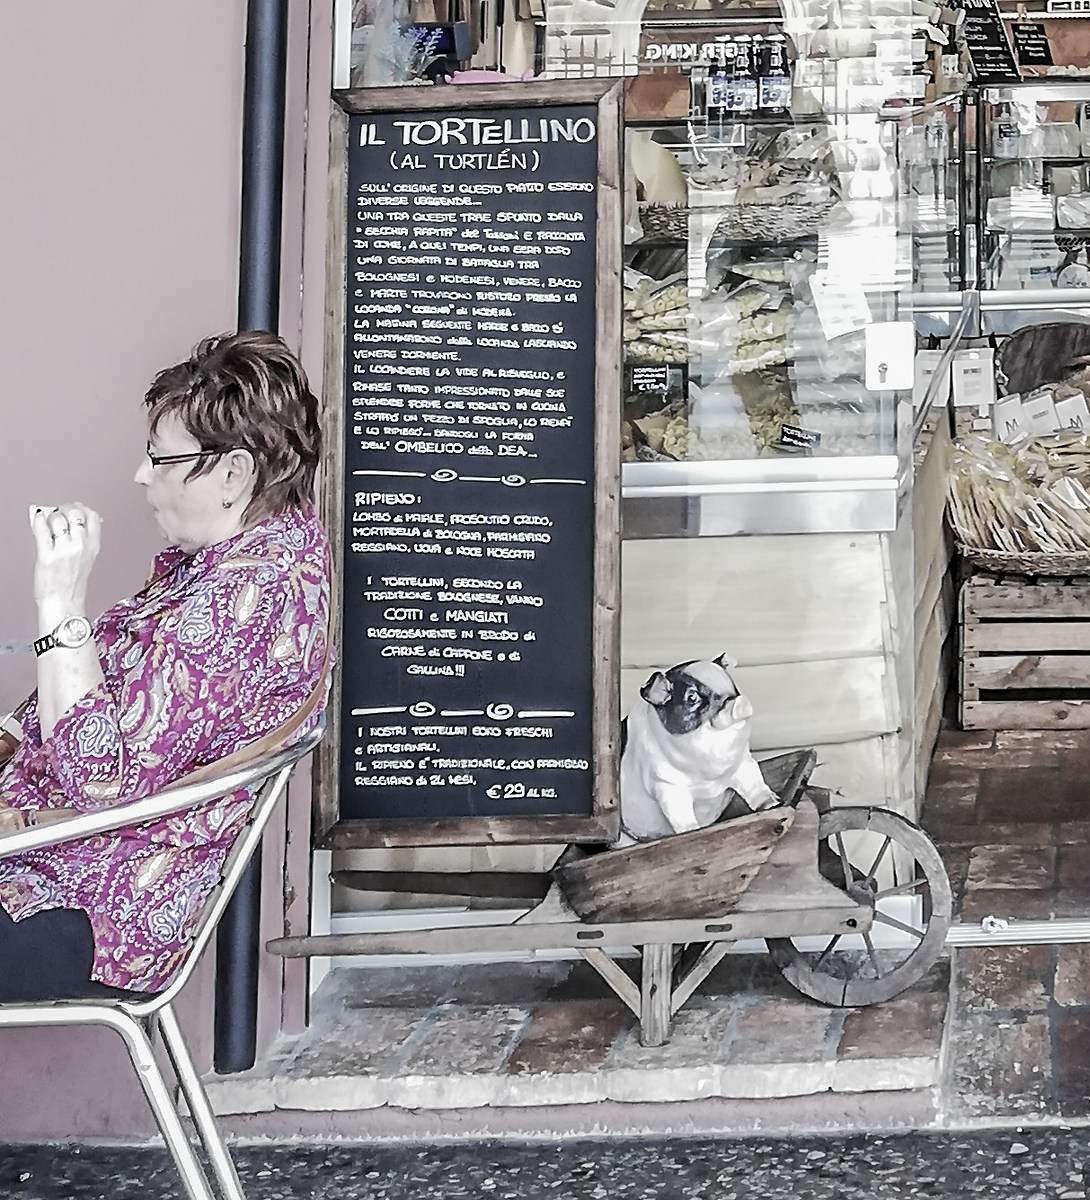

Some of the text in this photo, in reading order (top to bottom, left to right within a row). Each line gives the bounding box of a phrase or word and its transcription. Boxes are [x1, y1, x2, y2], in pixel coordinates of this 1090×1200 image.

[360, 118, 595, 146] IL TORTELLINO
[391, 151, 426, 169] (AL
[459, 184, 502, 194] QUESTO
[358, 197, 409, 205] DIVERSE
[358, 212, 583, 222] UNA TRA QUESTE TRAE SPUNTO DALLA
[524, 232, 533, 240] E
[353, 240, 368, 248] DI
[409, 240, 418, 249] A
[357, 256, 382, 264] UNA
[388, 256, 441, 264] GIORNATA
[445, 257, 457, 265] DI
[517, 261, 539, 269] TRA
[355, 272, 419, 281] BOLOGNESI
[565, 294, 577, 302] LA
[354, 320, 369, 328] LA
[354, 364, 497, 377] IL LA VIDE AL
[516, 402, 527, 410] IN
[524, 418, 537, 426] LO
[354, 426, 362, 434] E
[366, 427, 379, 435] LO
[485, 431, 497, 439] LA
[395, 441, 463, 453] OMBELICO
[353, 527, 420, 536] MORTADELLA
[507, 581, 522, 589] LA
[446, 610, 508, 623] MANGIATI
[462, 630, 473, 638] IN
[370, 726, 406, 736] NOSTRI
[505, 727, 552, 737] FRESCHI
[356, 762, 366, 771] IL
